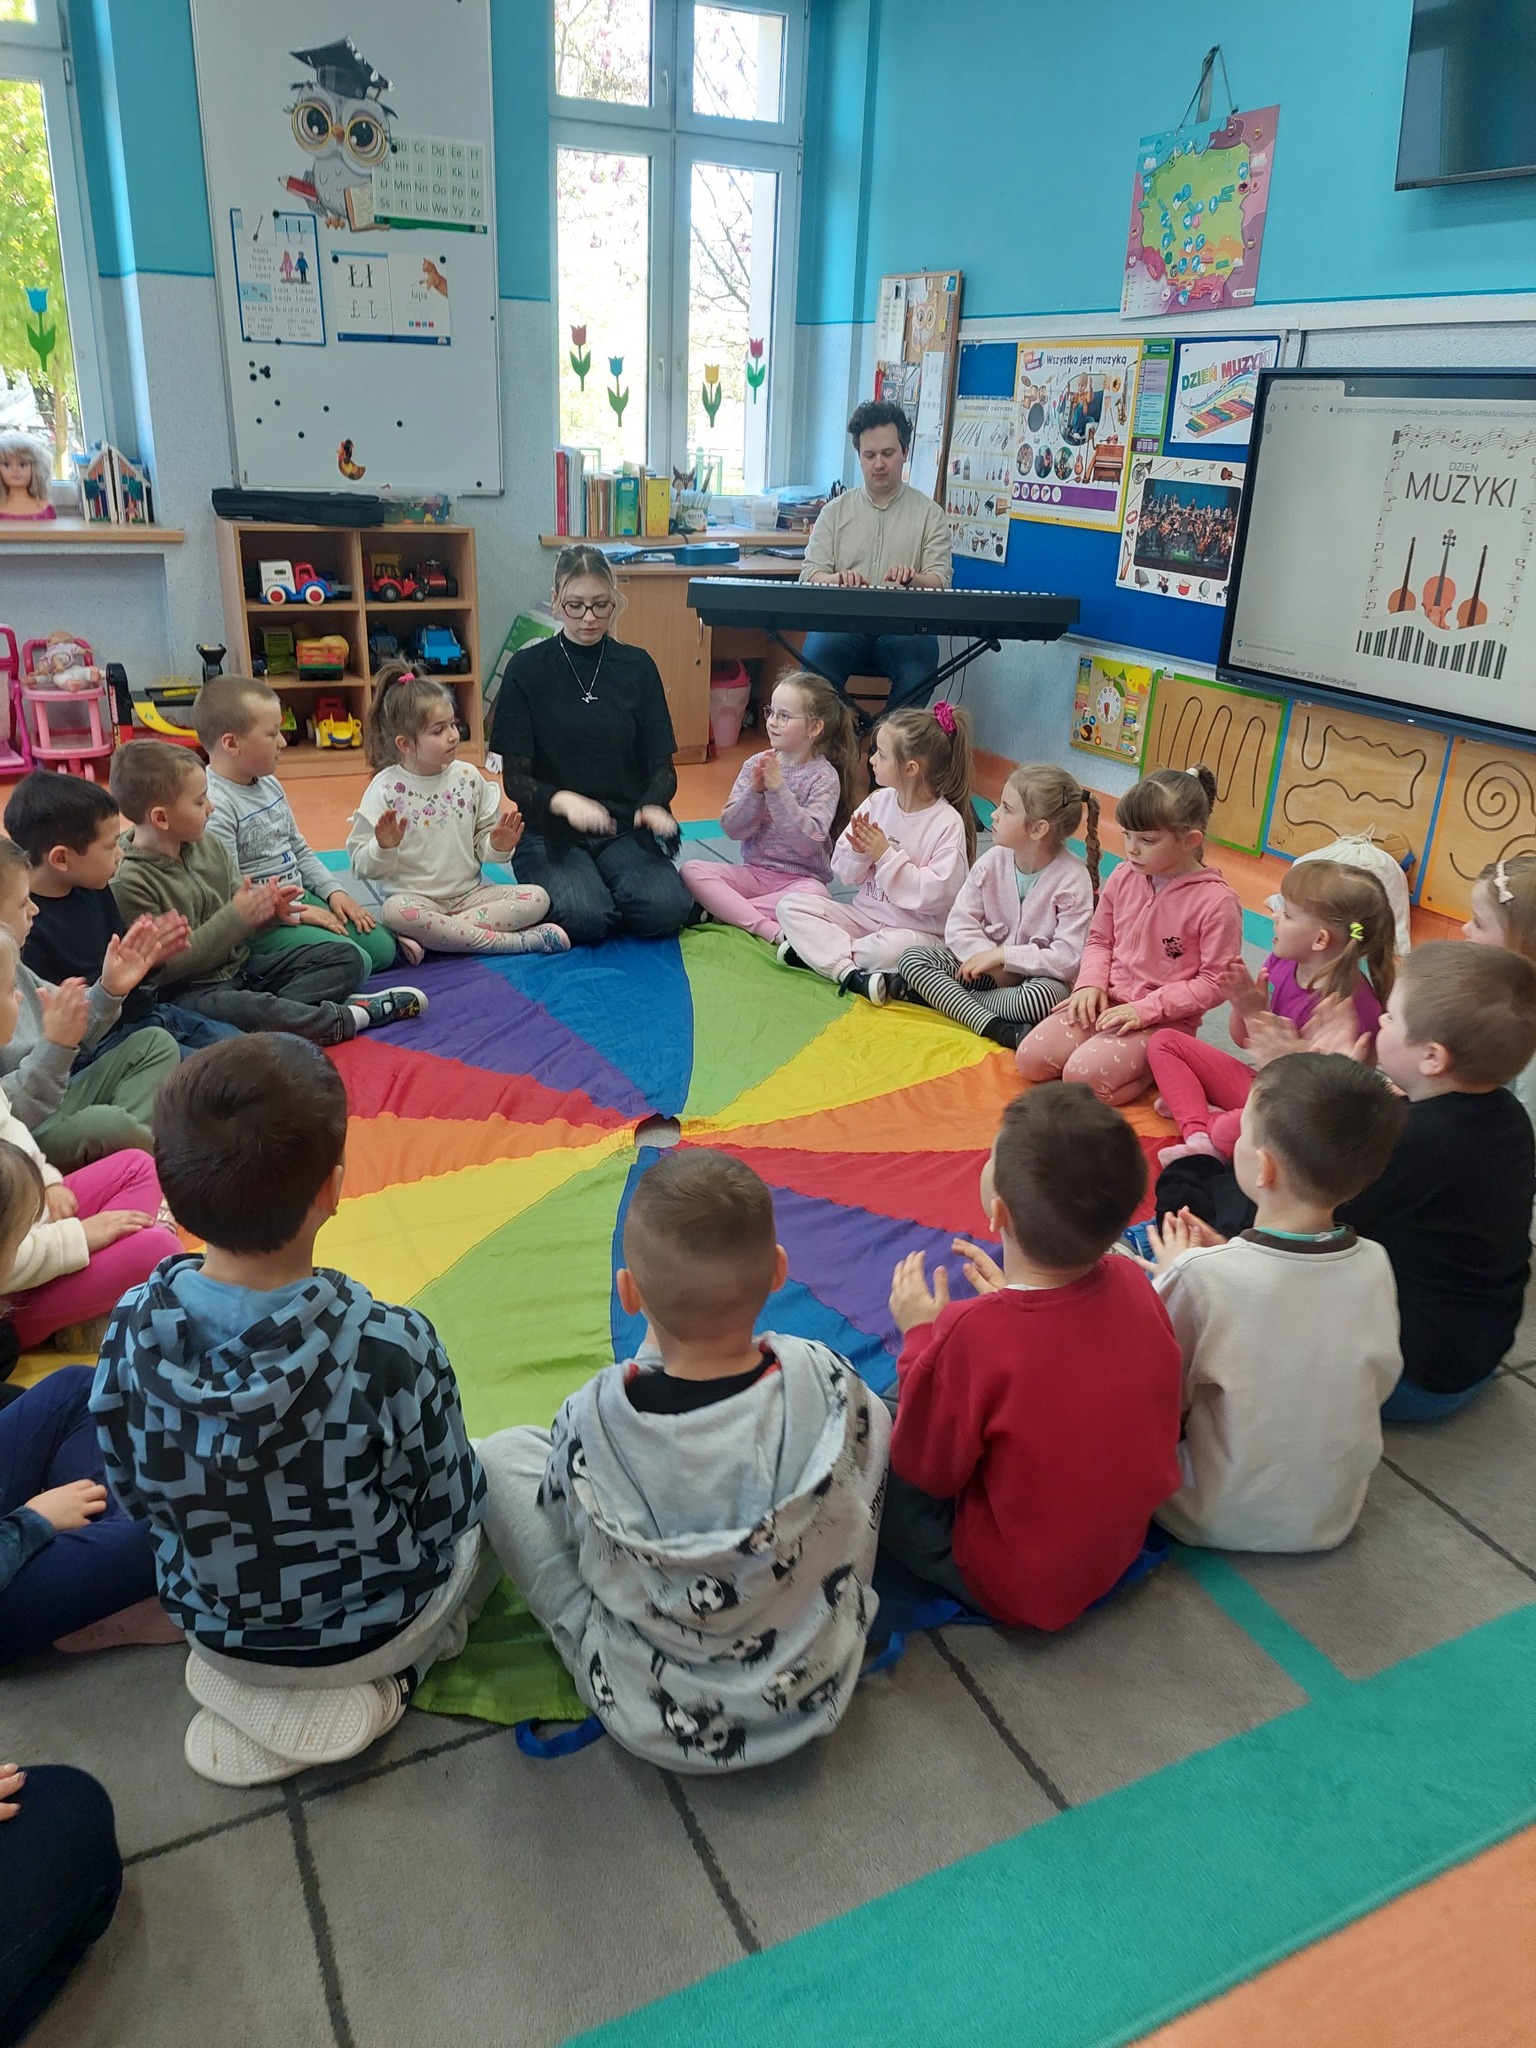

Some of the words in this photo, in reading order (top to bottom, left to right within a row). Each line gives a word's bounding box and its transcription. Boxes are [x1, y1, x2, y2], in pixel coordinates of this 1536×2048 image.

[431, 144, 445, 156] Dd
[451, 147, 462, 158] Ee
[396, 160, 408, 172] Hh
[452, 167, 463, 177] Kk
[394, 180, 412, 190] Mm
[414, 182, 428, 192] Nn
[432, 184, 447, 195] Oo
[452, 186, 463, 198] Pp
[416, 201, 428, 212] Uu
[432, 203, 448, 214] Ww
[453, 205, 464, 218] Yy
[1046, 354, 1078, 366] Wszystko
[1079, 355, 1094, 366] jest
[1096, 355, 1127, 366] muzyką
[1181, 362, 1218, 391] DZIEŃ
[1221, 349, 1273, 379] MUZYKI
[1448, 461, 1478, 472] DZIEŃ
[1405, 471, 1518, 508] MUZYKI
[1307, 671, 1314, 680] 30
